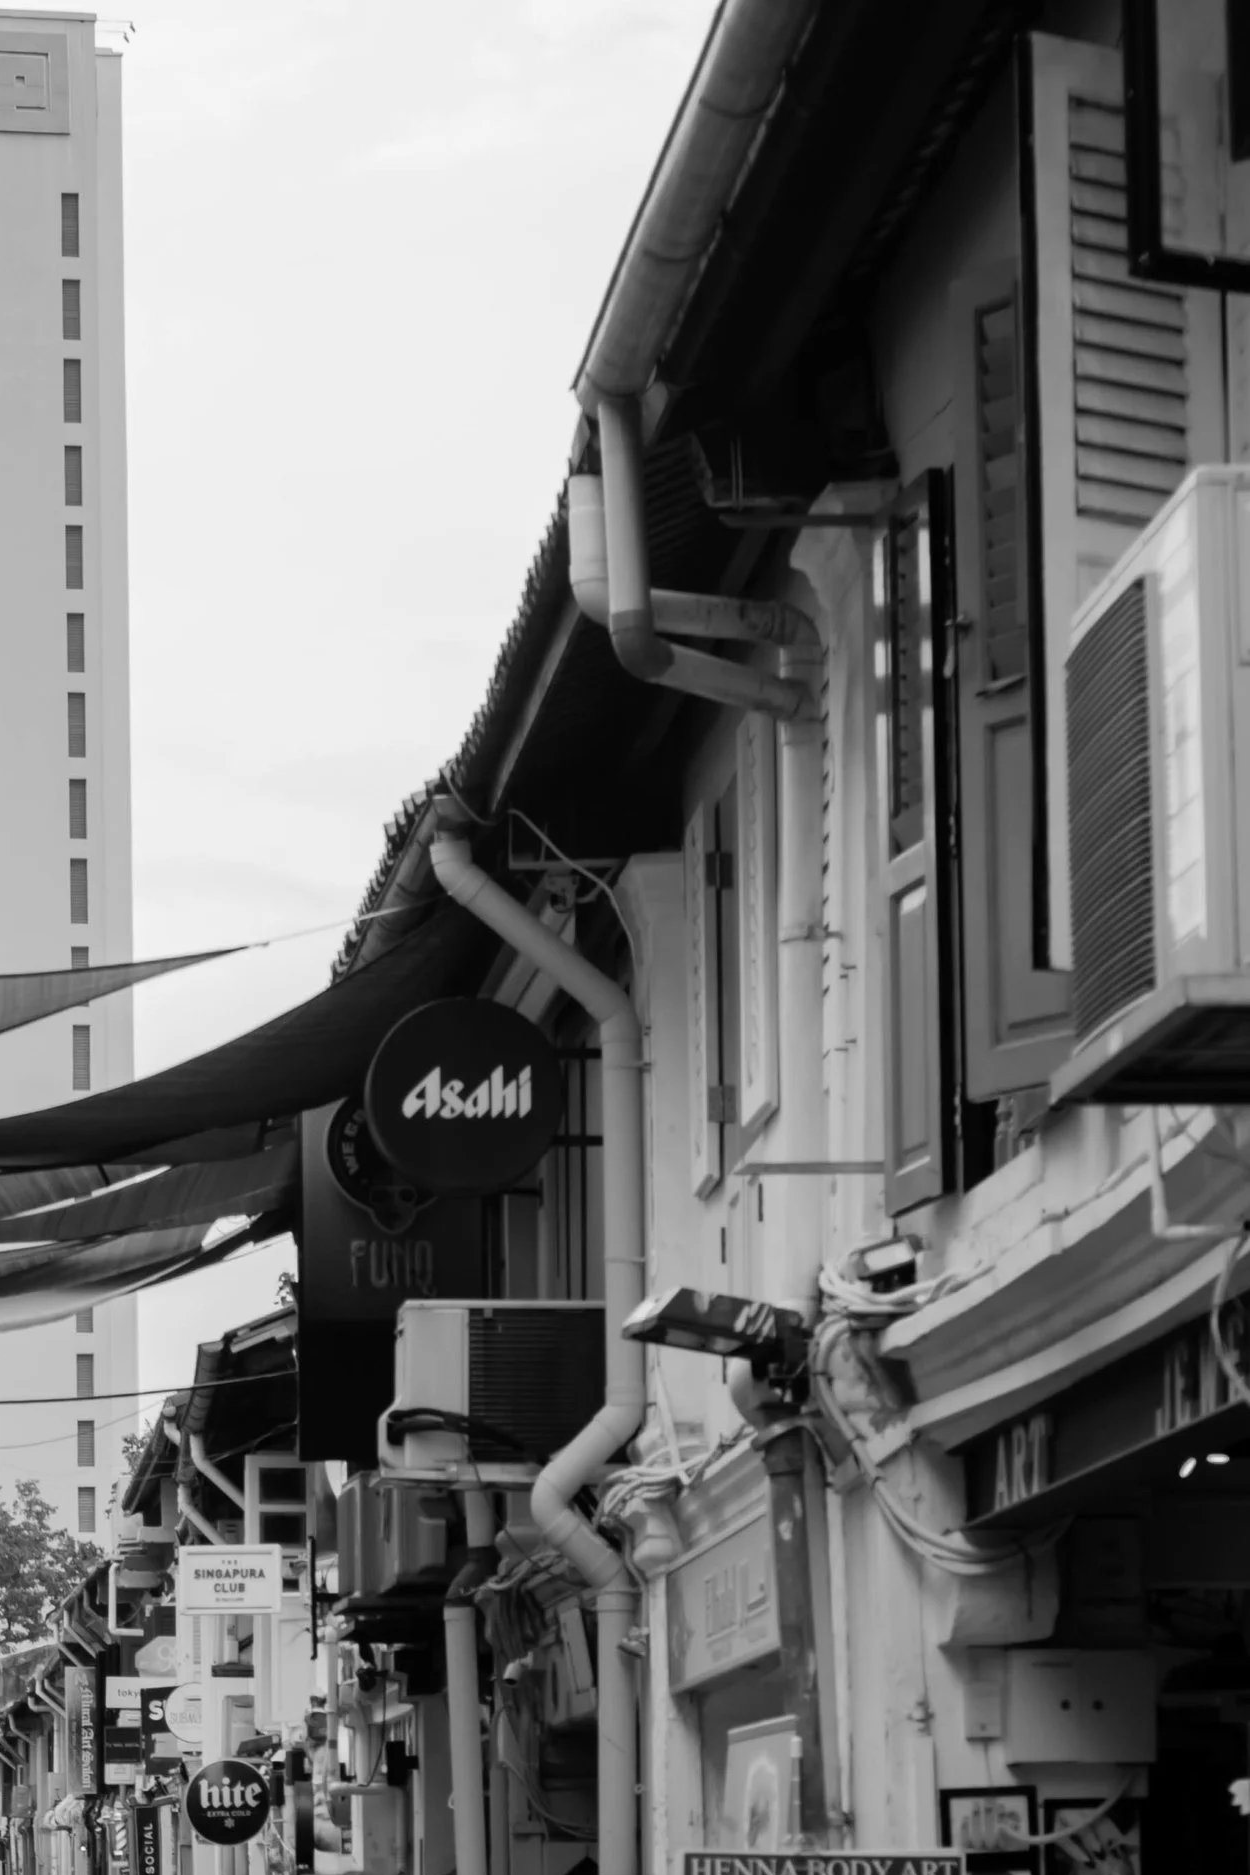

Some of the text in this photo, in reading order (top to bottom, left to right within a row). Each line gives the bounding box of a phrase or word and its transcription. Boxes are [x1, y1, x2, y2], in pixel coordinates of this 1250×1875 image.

[402, 1064, 532, 1120] Asahi
[350, 1239, 437, 1298] FUNQ
[994, 1414, 1052, 1512] ART
[194, 1568, 266, 1579] SINGAPURA
[213, 1582, 246, 1593] CLUB
[117, 1688, 142, 1700] toky
[199, 1776, 263, 1809] hite
[143, 1823, 156, 1875] SOCIAL
